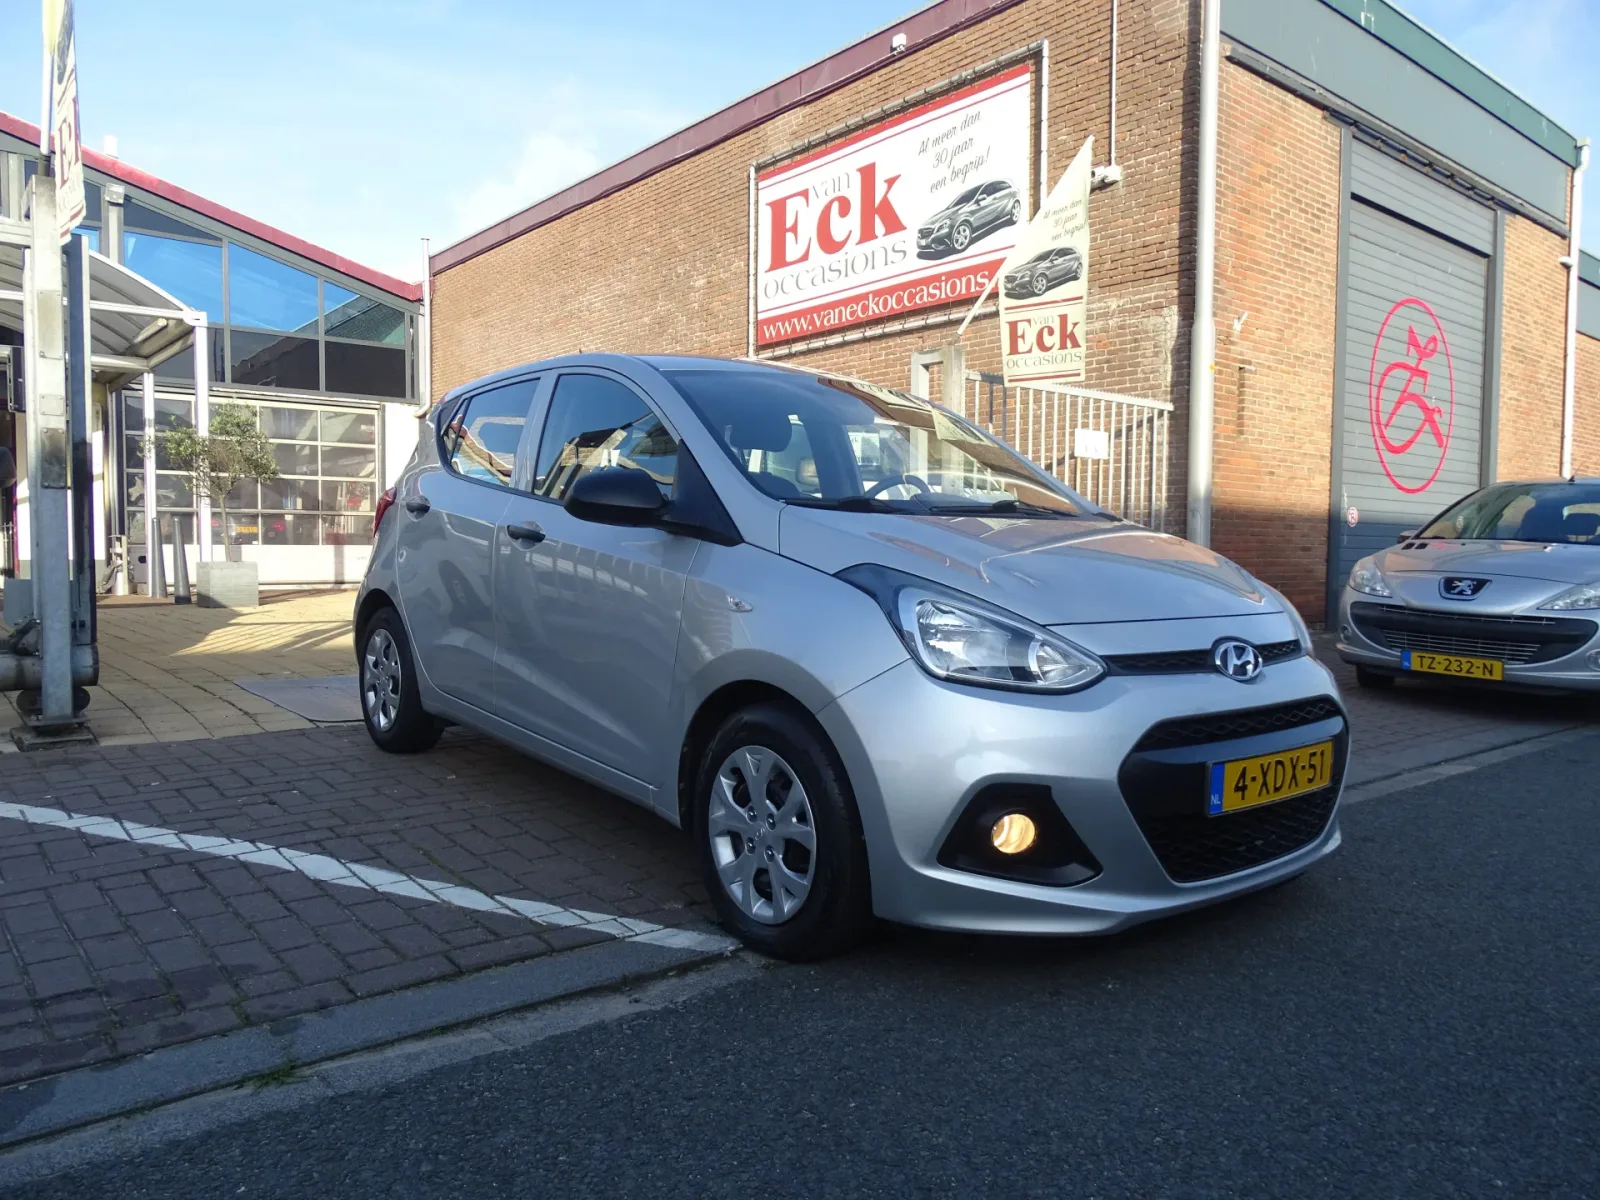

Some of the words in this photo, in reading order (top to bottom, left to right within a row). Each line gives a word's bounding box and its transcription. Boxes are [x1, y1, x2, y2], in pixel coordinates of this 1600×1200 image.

[917, 137, 930, 156] Al
[931, 126, 957, 148] meer
[960, 111, 981, 131] dan
[930, 176, 947, 193] een
[950, 145, 991, 184] begrip!
[932, 148, 949, 168] 30
[947, 137, 974, 169] jaar
[812, 172, 850, 199] van
[764, 161, 908, 273] Eck
[763, 240, 907, 299] occasions
[1005, 313, 1082, 357] Eck
[1032, 314, 1055, 326] van
[1006, 351, 1082, 369] occasions
[1417, 655, 1494, 677] TZ-232-N
[1233, 748, 1326, 801] 4-XDX-51
[1210, 794, 1221, 805] NL
